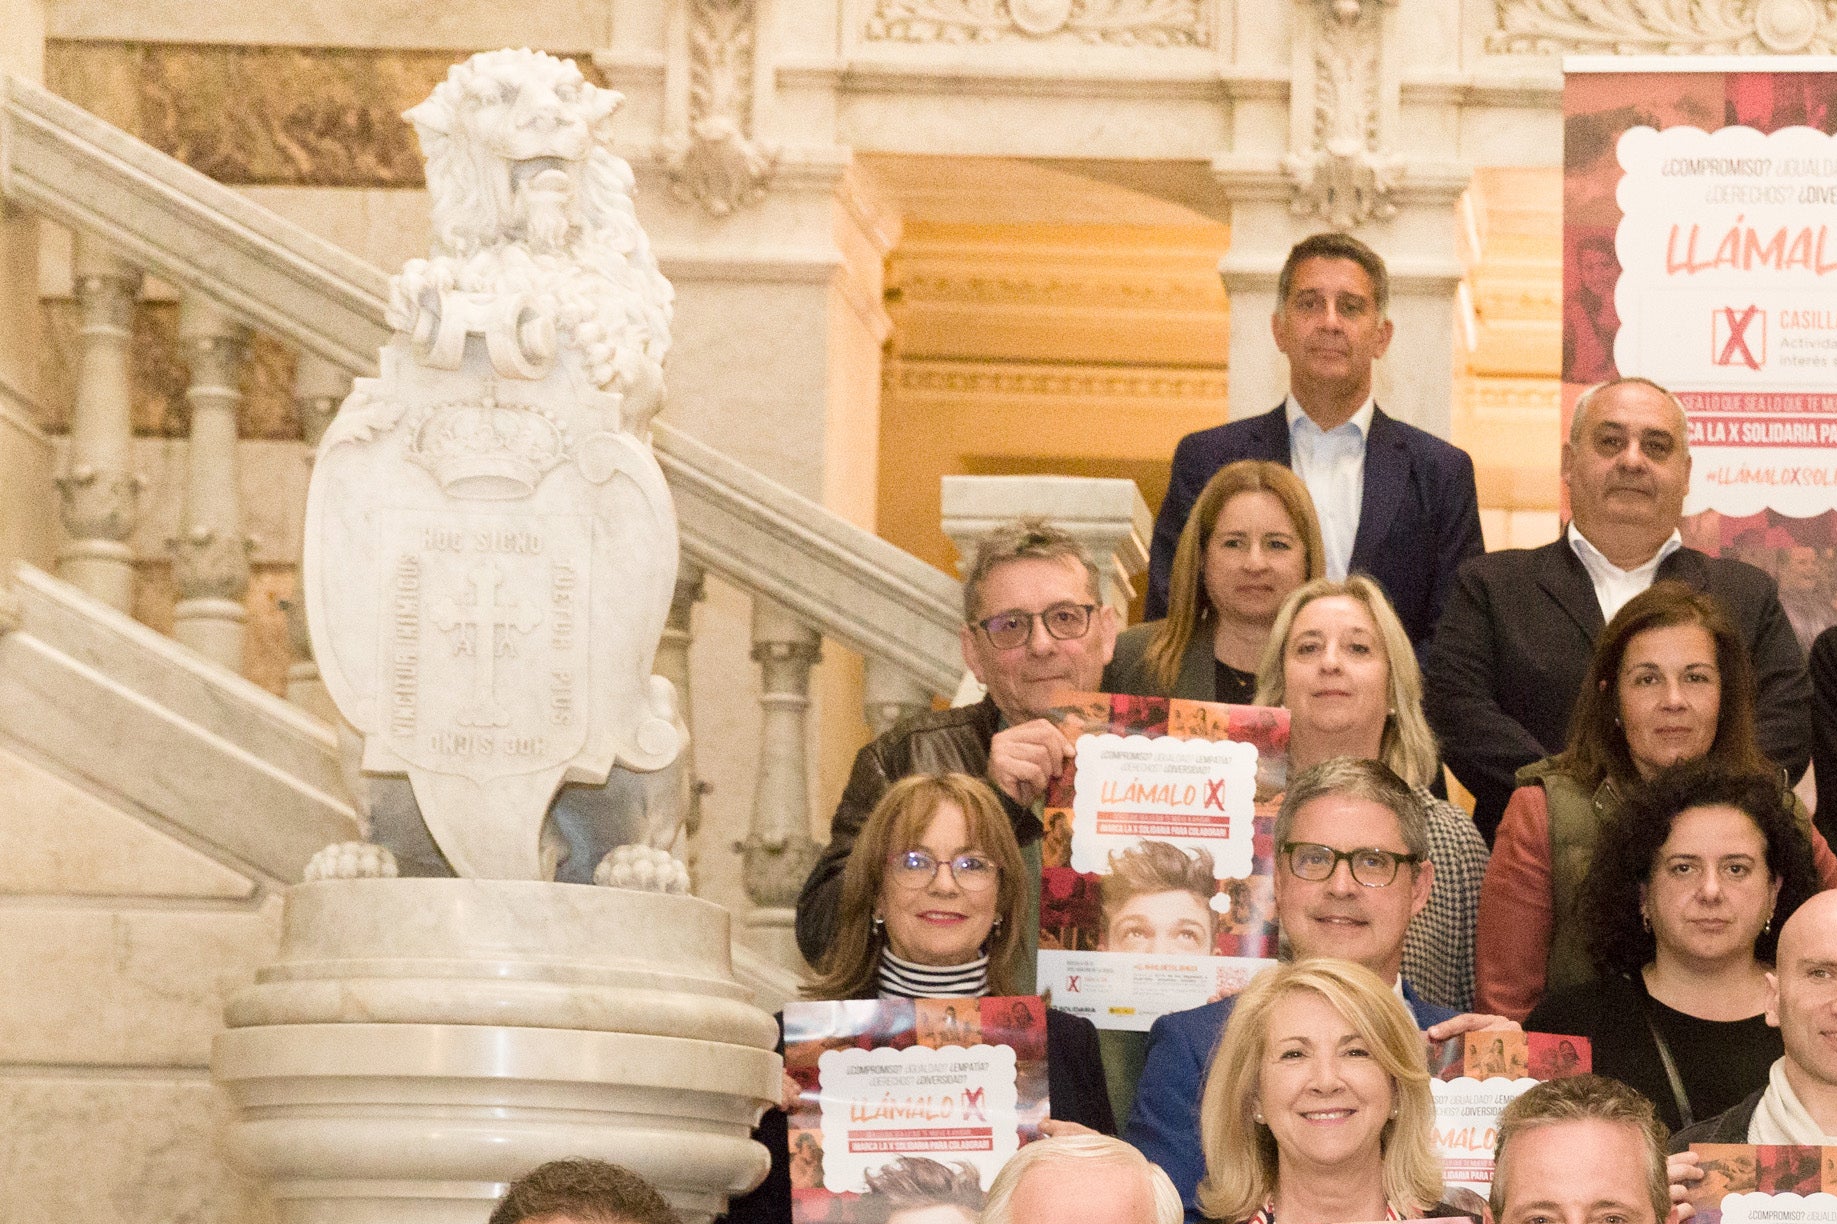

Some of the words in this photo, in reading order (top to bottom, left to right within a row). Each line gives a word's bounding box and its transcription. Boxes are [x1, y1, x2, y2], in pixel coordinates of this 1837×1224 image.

[1661, 158, 1771, 177] ¿COMPROMISO?
[1780, 354, 1828, 369] interés
[1707, 423, 1725, 442] LA
[1728, 424, 1739, 442] X
[1742, 423, 1816, 443] SOLIDARIA
[1101, 777, 1196, 807] LLÁMALO
[1748, 1211, 1805, 1220] ¿COMPROMISO?
